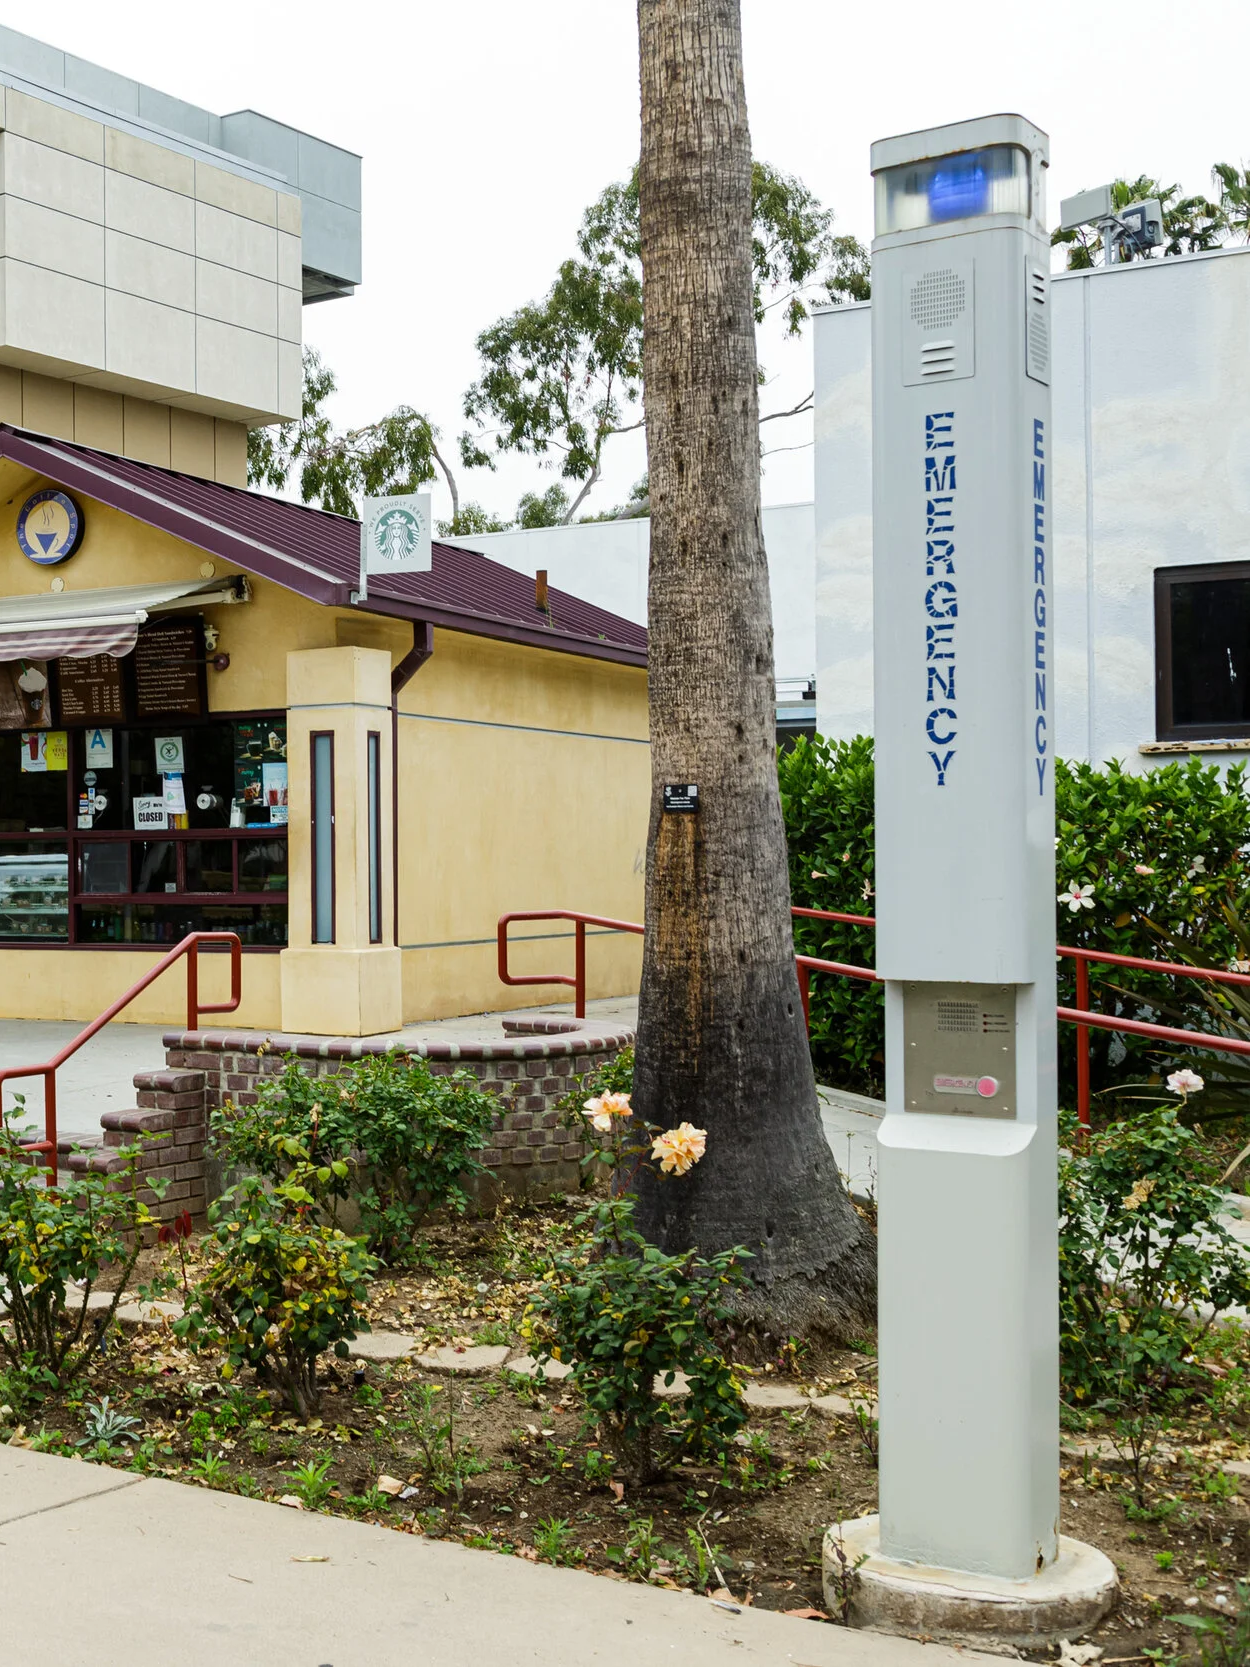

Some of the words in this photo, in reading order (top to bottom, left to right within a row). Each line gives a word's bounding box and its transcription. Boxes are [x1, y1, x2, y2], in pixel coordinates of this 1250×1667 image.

[25, 493, 66, 512] Coffee
[369, 516, 376, 528] WE
[376, 501, 407, 515] PROUDLY
[408, 503, 426, 524] SERVE
[925, 411, 958, 786] EMERGENCY
[1033, 418, 1048, 797] EMERGENCY
[90, 729, 106, 749] A
[138, 811, 163, 822] CLOSED
